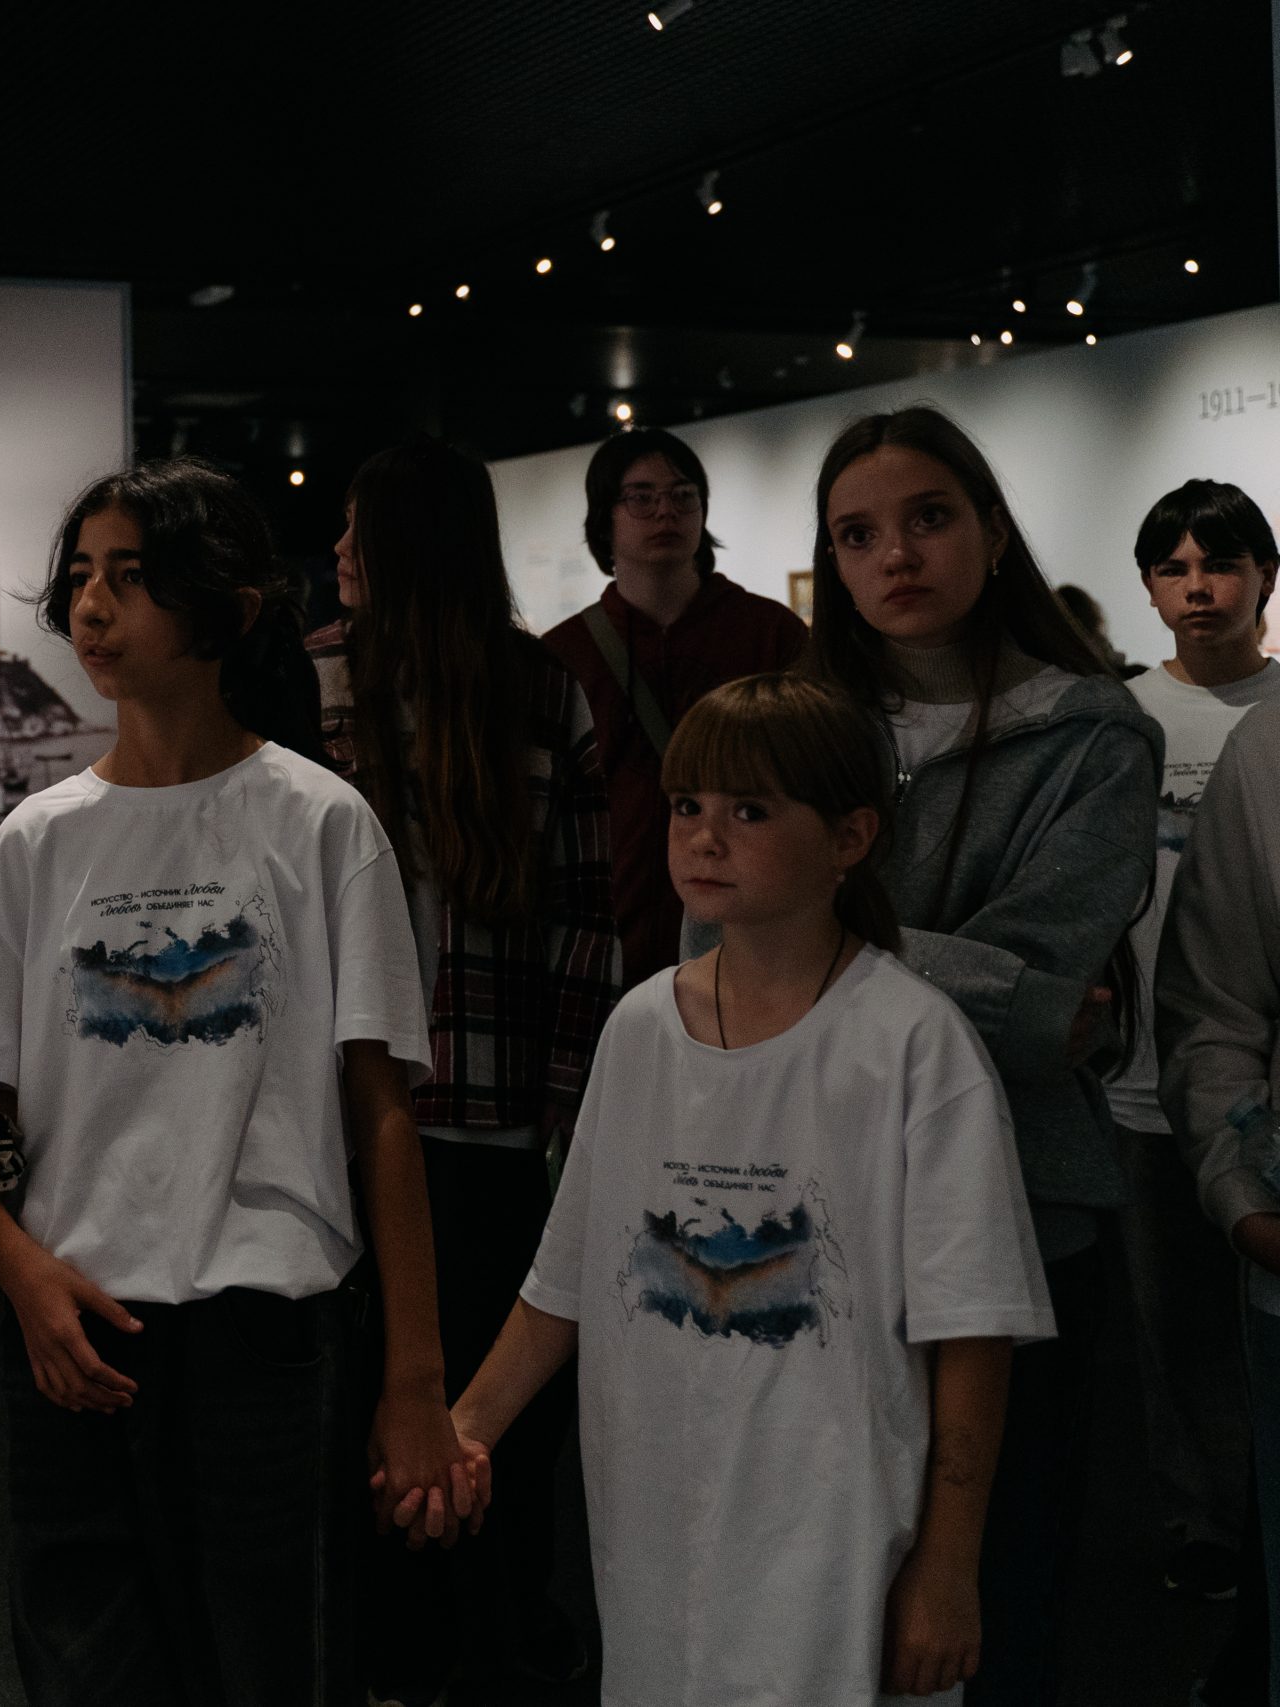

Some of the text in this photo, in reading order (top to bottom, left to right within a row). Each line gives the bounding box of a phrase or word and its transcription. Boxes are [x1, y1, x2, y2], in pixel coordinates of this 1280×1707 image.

[1199, 383, 1280, 421] 1911—1
[90, 892, 134, 907] ИСКУССТВО
[141, 888, 182, 899] ИСТОЧНИК
[184, 881, 226, 896] Любви
[100, 899, 215, 918] Любовь ОБЪЕДИНЯЕТ НАС
[697, 1164, 741, 1175] ИСТОЧНИК
[703, 1179, 754, 1191] ОБЪЕДИНЯЕТ
[757, 1182, 777, 1192] НАС
